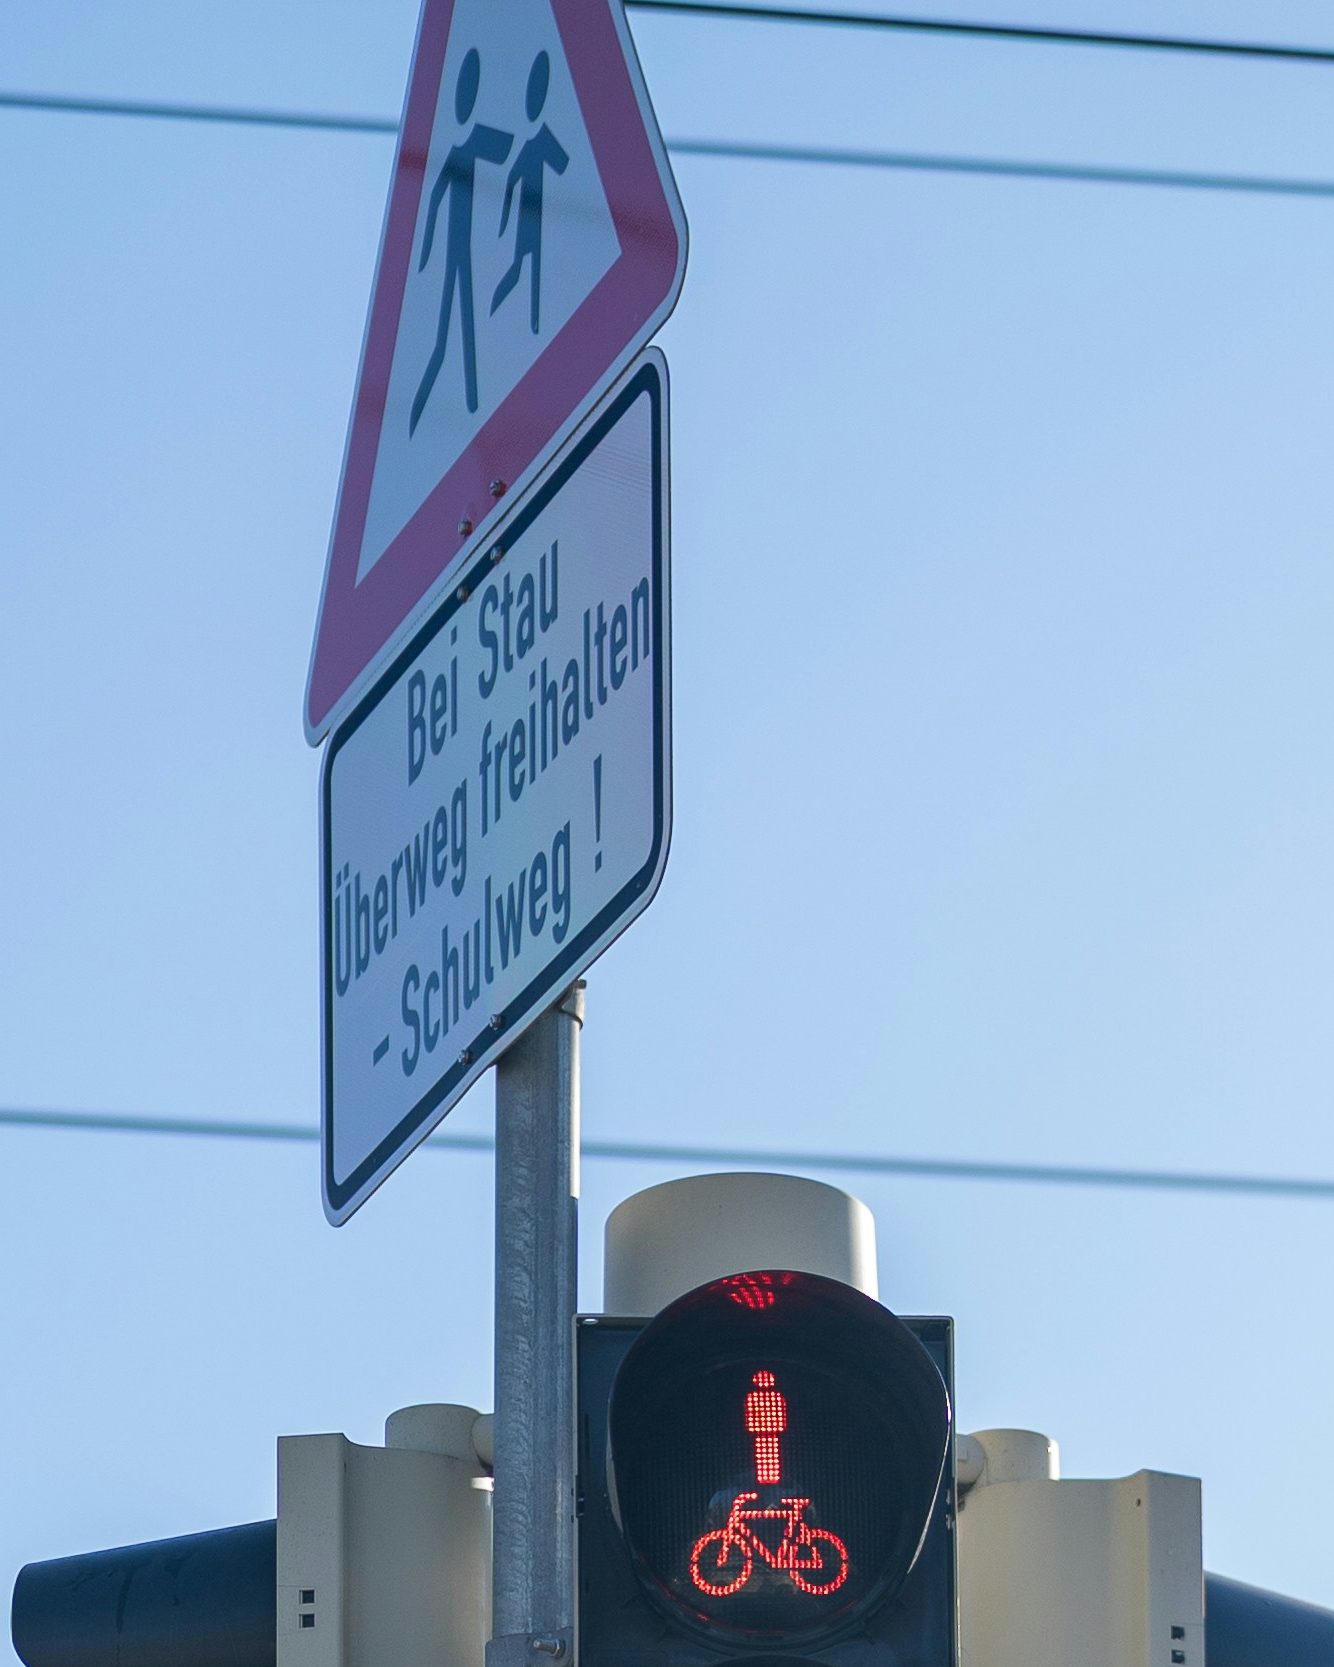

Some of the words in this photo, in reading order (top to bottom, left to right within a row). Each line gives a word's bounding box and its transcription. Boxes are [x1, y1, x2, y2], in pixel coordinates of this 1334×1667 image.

[334, 777, 467, 997] Überweg
[479, 576, 649, 838] freihalten
[407, 625, 457, 787] Bei
[478, 538, 558, 699] Stau
[401, 819, 571, 1077] Schulweg
[593, 753, 602, 874] !
